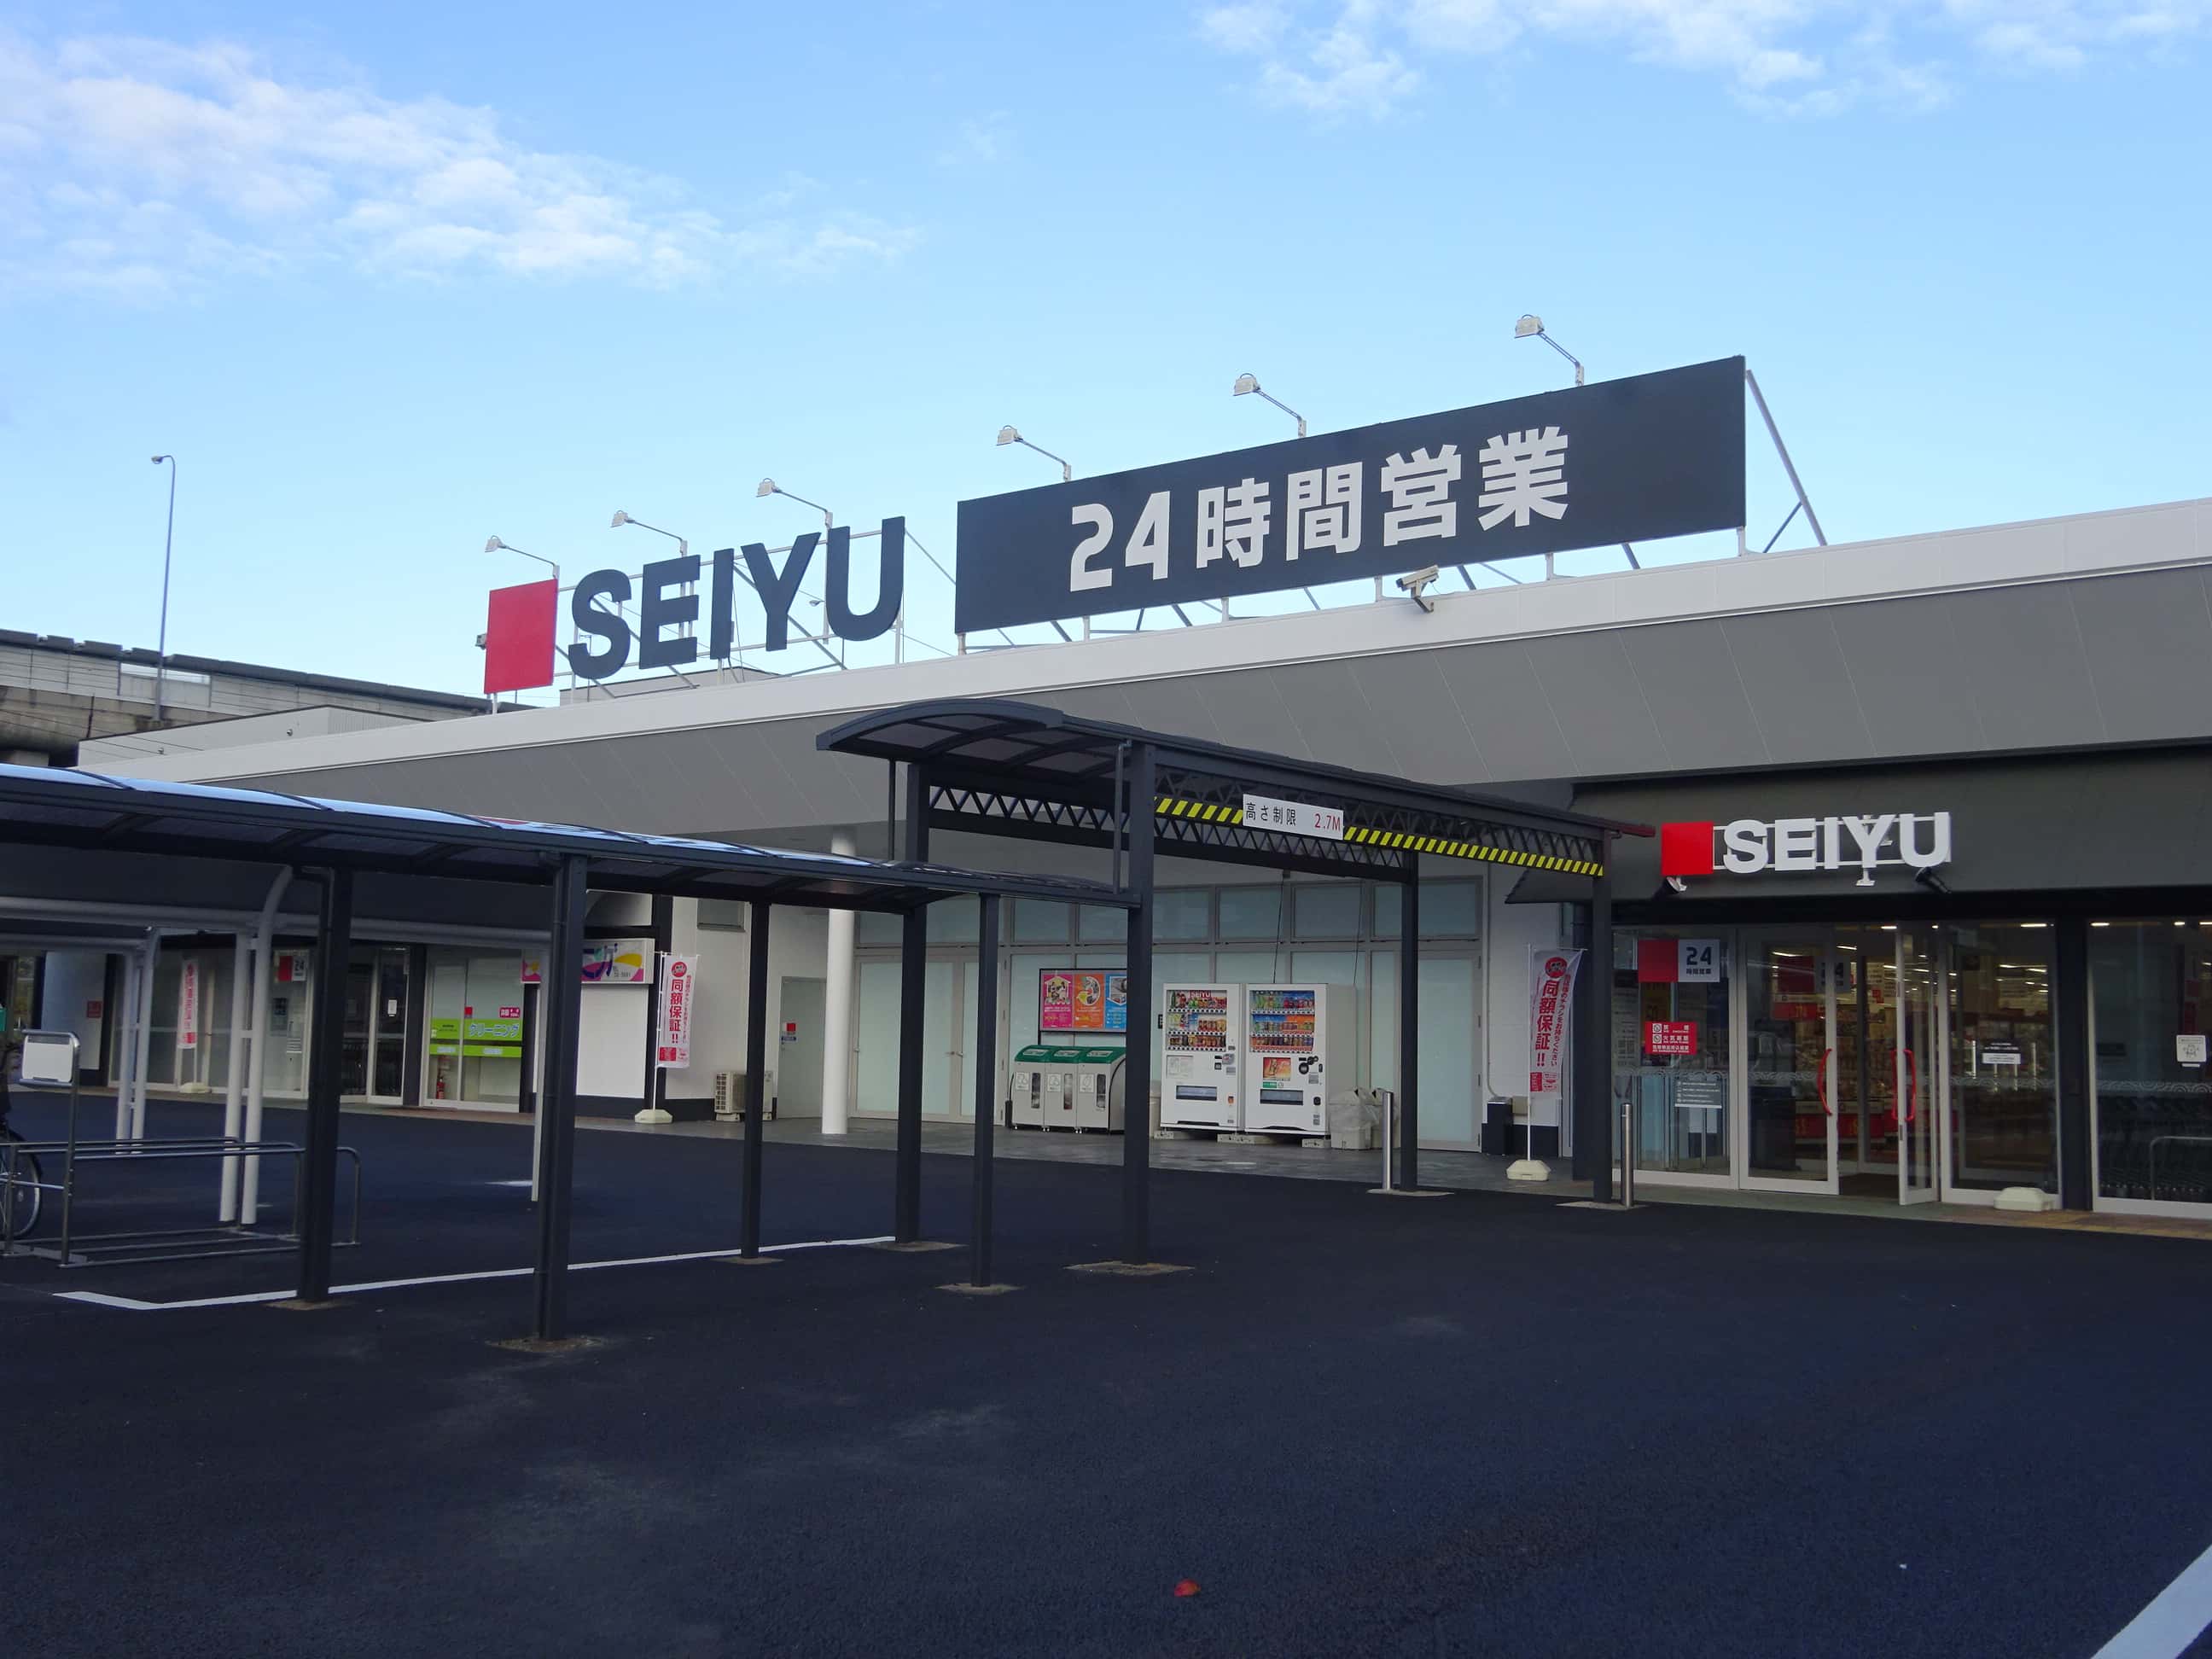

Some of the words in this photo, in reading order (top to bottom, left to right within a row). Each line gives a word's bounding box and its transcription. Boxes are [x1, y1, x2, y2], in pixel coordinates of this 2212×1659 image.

[1068, 425, 1569, 592] 24時間営業
[568, 515, 905, 679] SEIYU
[1245, 801, 1296, 826] 高さ制限
[1314, 813, 1341, 831] 2.7M
[1722, 812, 1951, 873] SEIYU
[1686, 946, 1711, 965] 24
[469, 1022, 520, 1037] クリーニング
